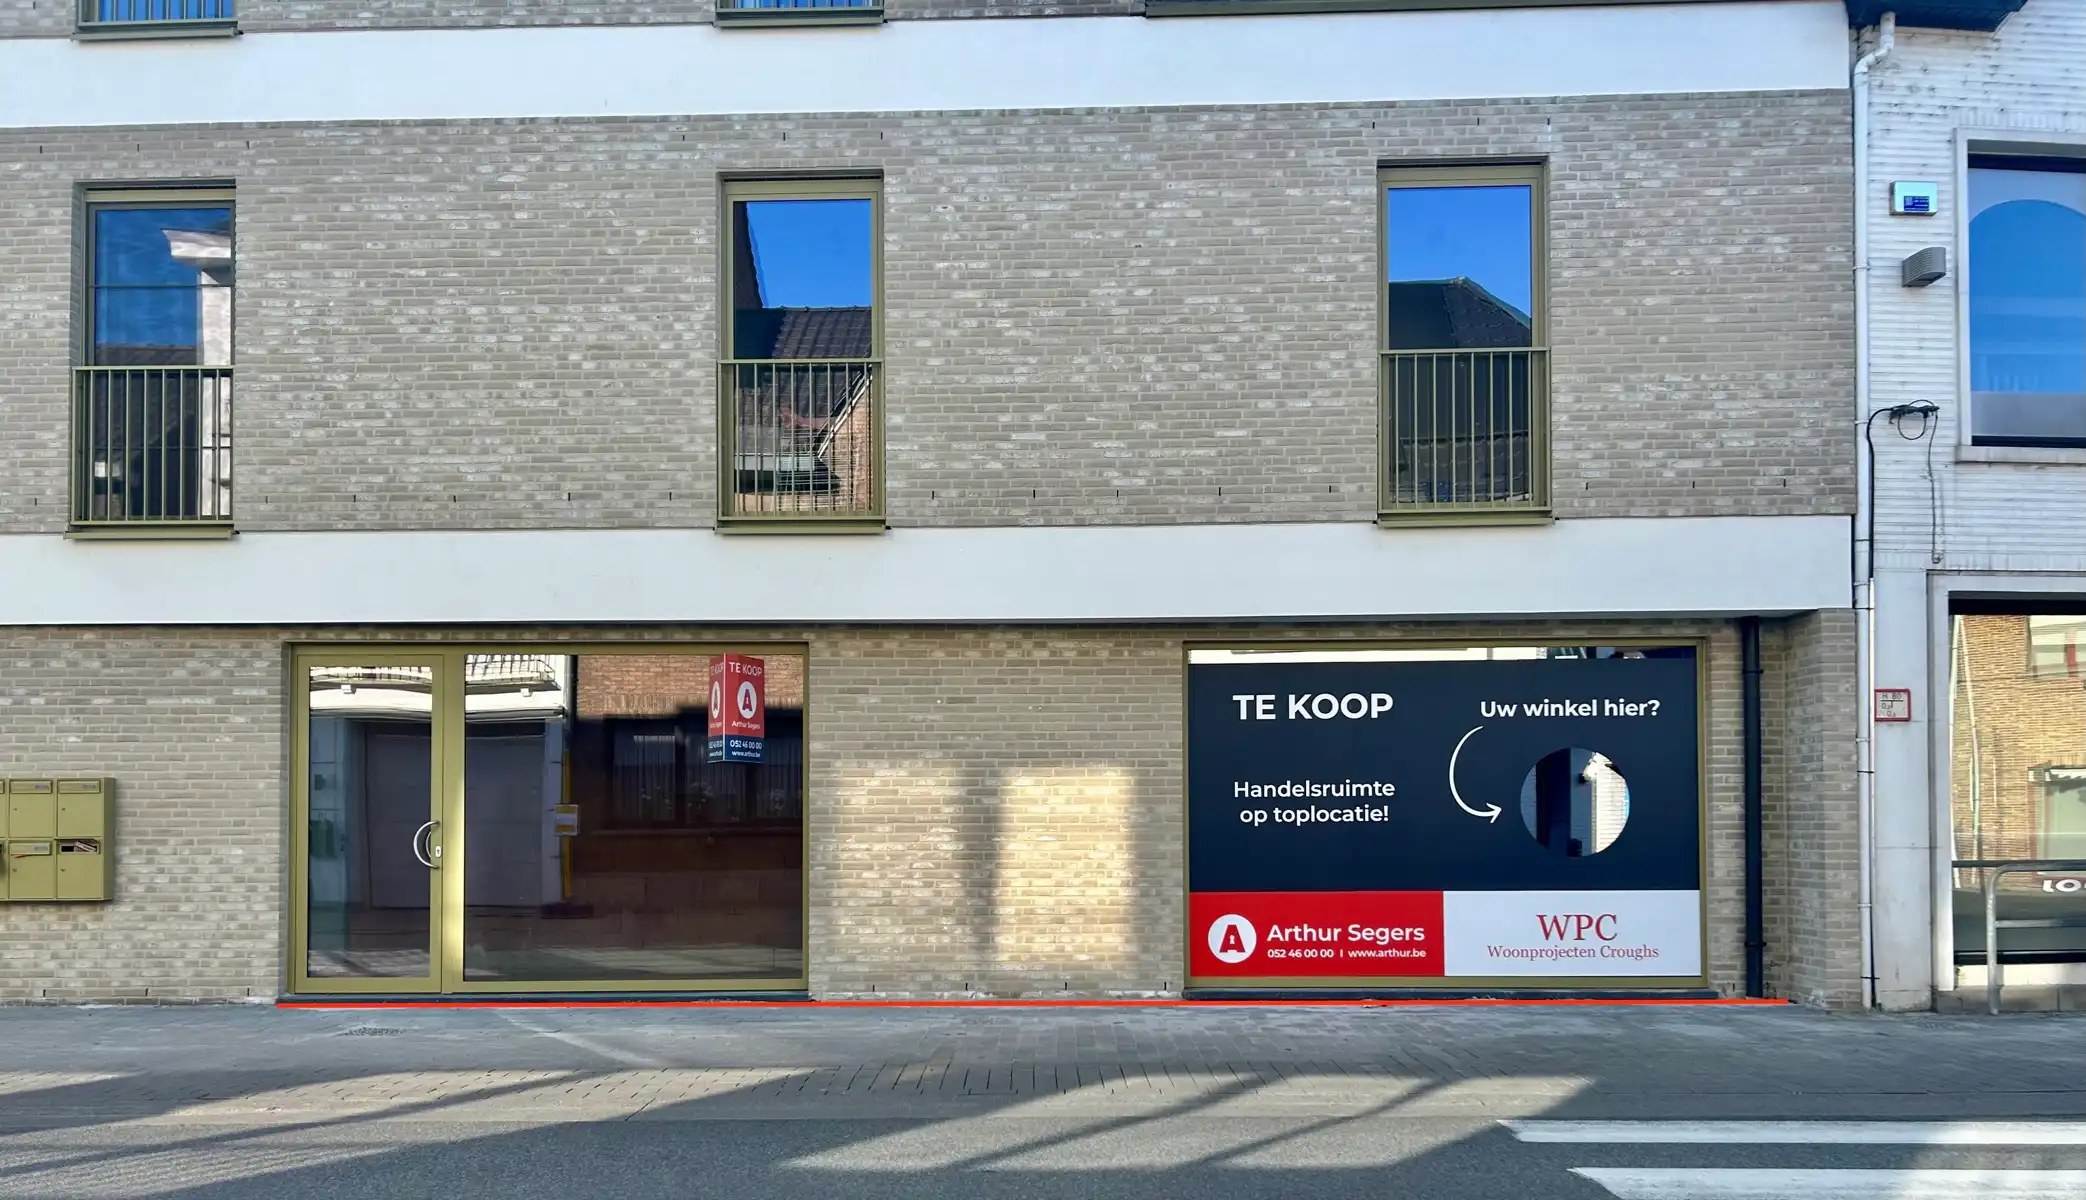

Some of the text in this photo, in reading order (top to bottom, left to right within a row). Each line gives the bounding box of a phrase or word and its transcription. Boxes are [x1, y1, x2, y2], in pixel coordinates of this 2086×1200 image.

[729, 661, 762, 676] TE KOOP
[1233, 693, 1393, 720] TE KOOP
[1481, 698, 1660, 717] Uw winkel hier?
[730, 740, 742, 748] 052
[1234, 779, 1395, 798] Handelsruimte
[1240, 804, 1389, 826] op toplocatie!
[1266, 923, 1425, 945] Arthur Segers
[1536, 913, 1618, 941] WPC
[1267, 948, 1286, 958] 052
[1287, 948, 1302, 958] 46
[1304, 948, 1318, 958] 00
[1319, 948, 1334, 958] 00
[1347, 948, 1427, 958] www.arthur.be
[1487, 944, 1660, 961] Woonprojecten Croughs
